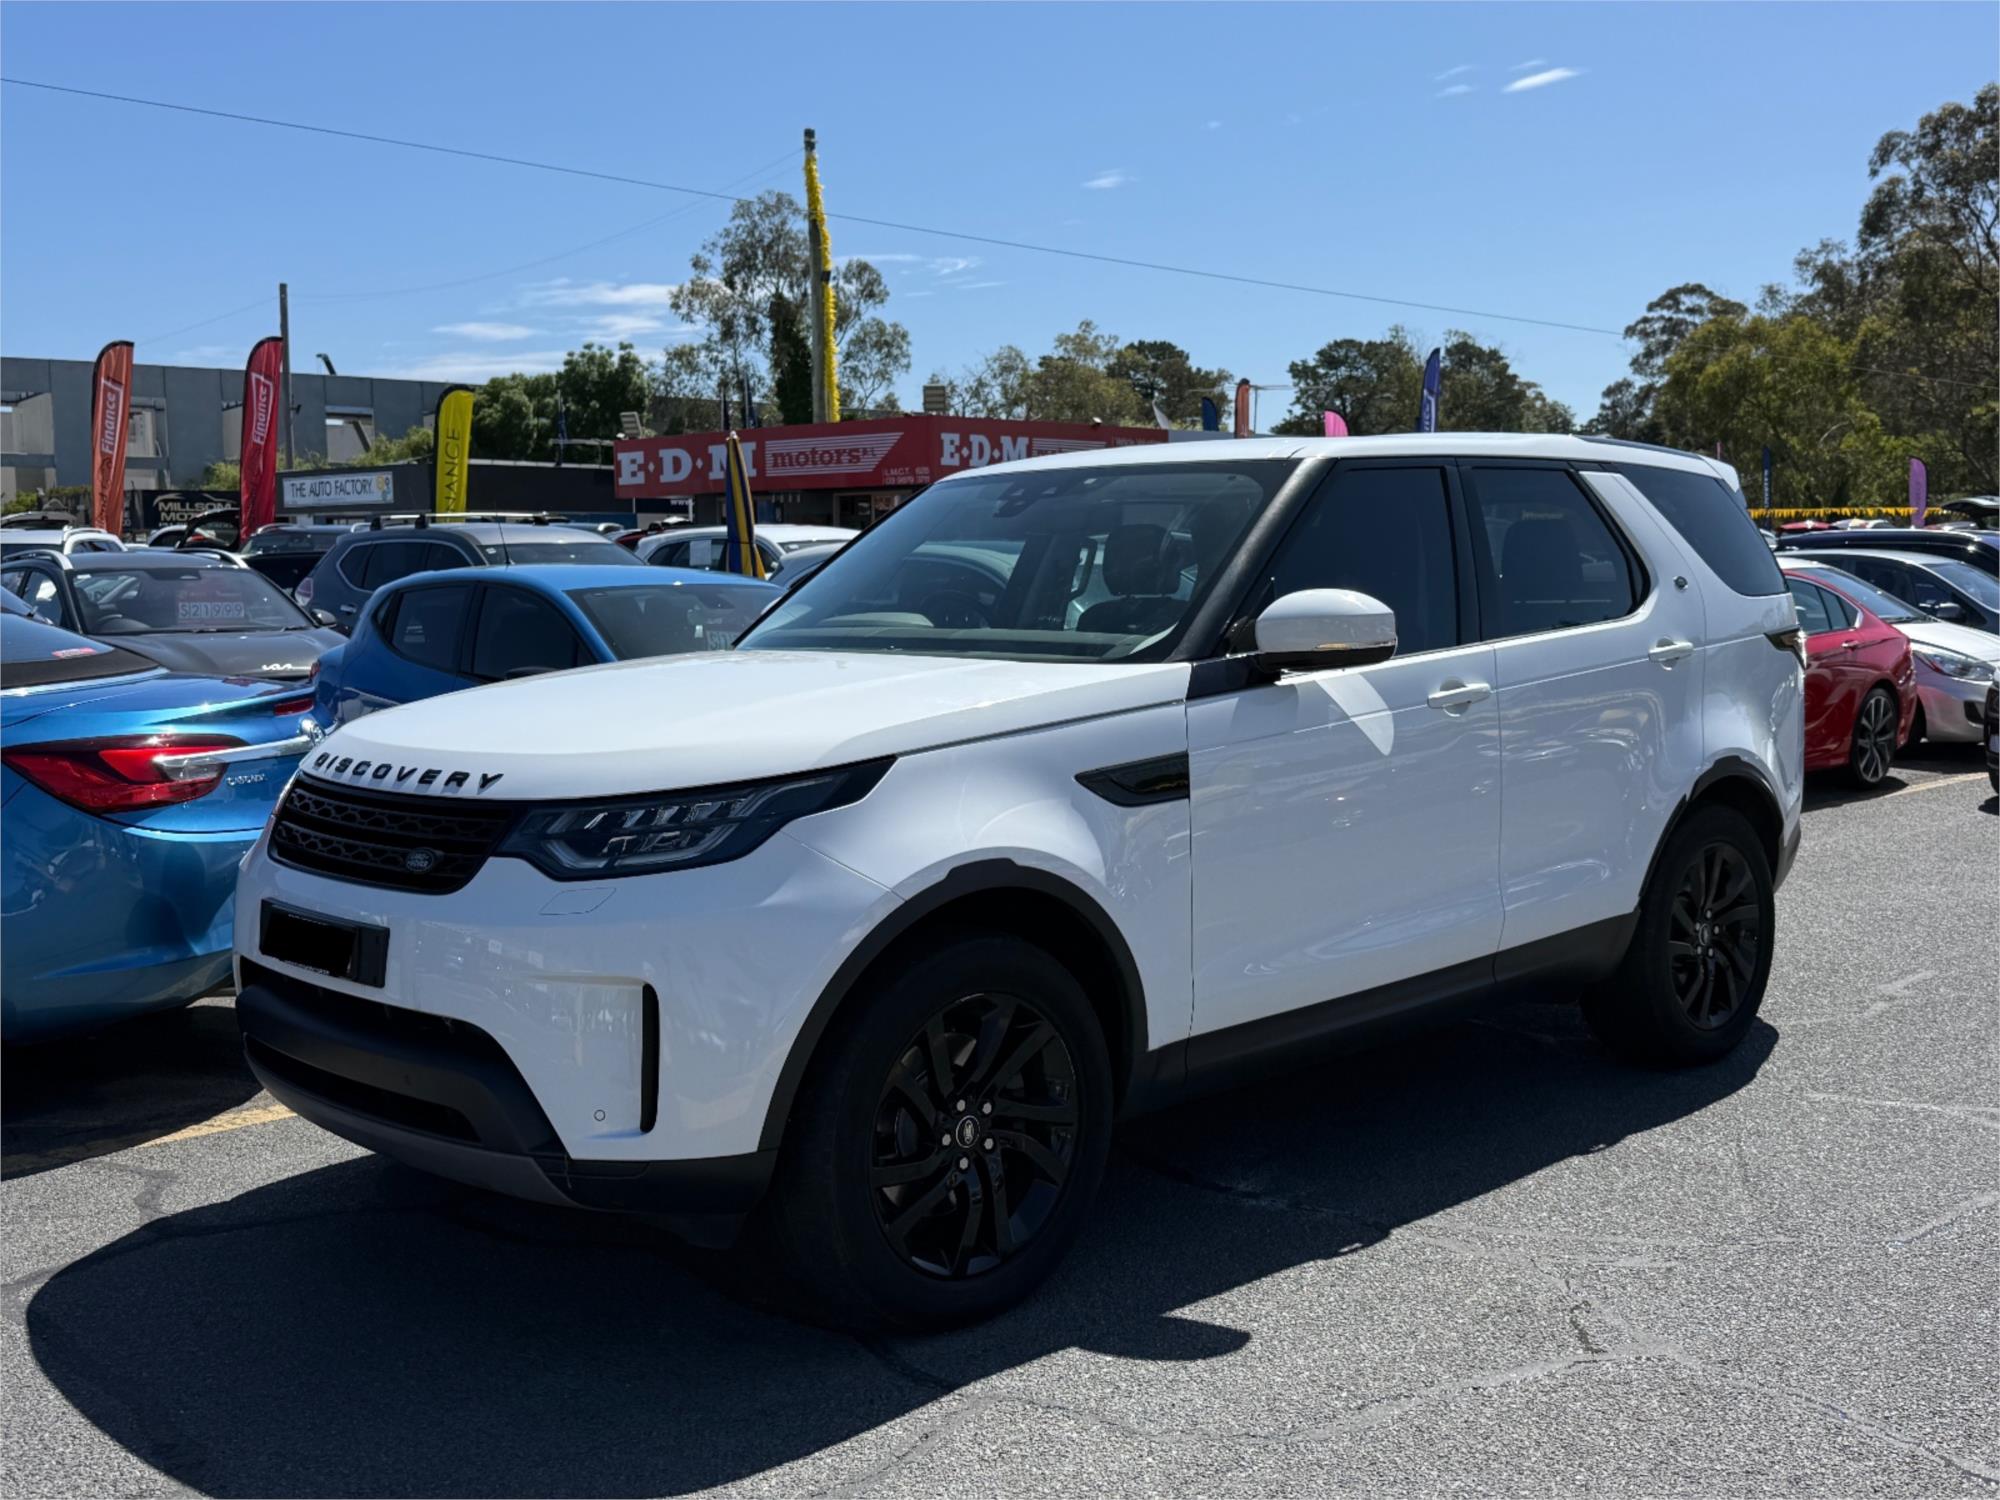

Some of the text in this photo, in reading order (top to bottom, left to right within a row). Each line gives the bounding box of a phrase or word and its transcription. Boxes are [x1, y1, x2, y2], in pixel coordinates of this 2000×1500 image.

[102, 390, 117, 454] Finance
[252, 384, 268, 445] Finance
[444, 427, 460, 514] NANCE
[772, 448, 862, 467] motors
[291, 479, 372, 498] THE AUTO FACTORY
[314, 752, 504, 790] DISCOVERY
